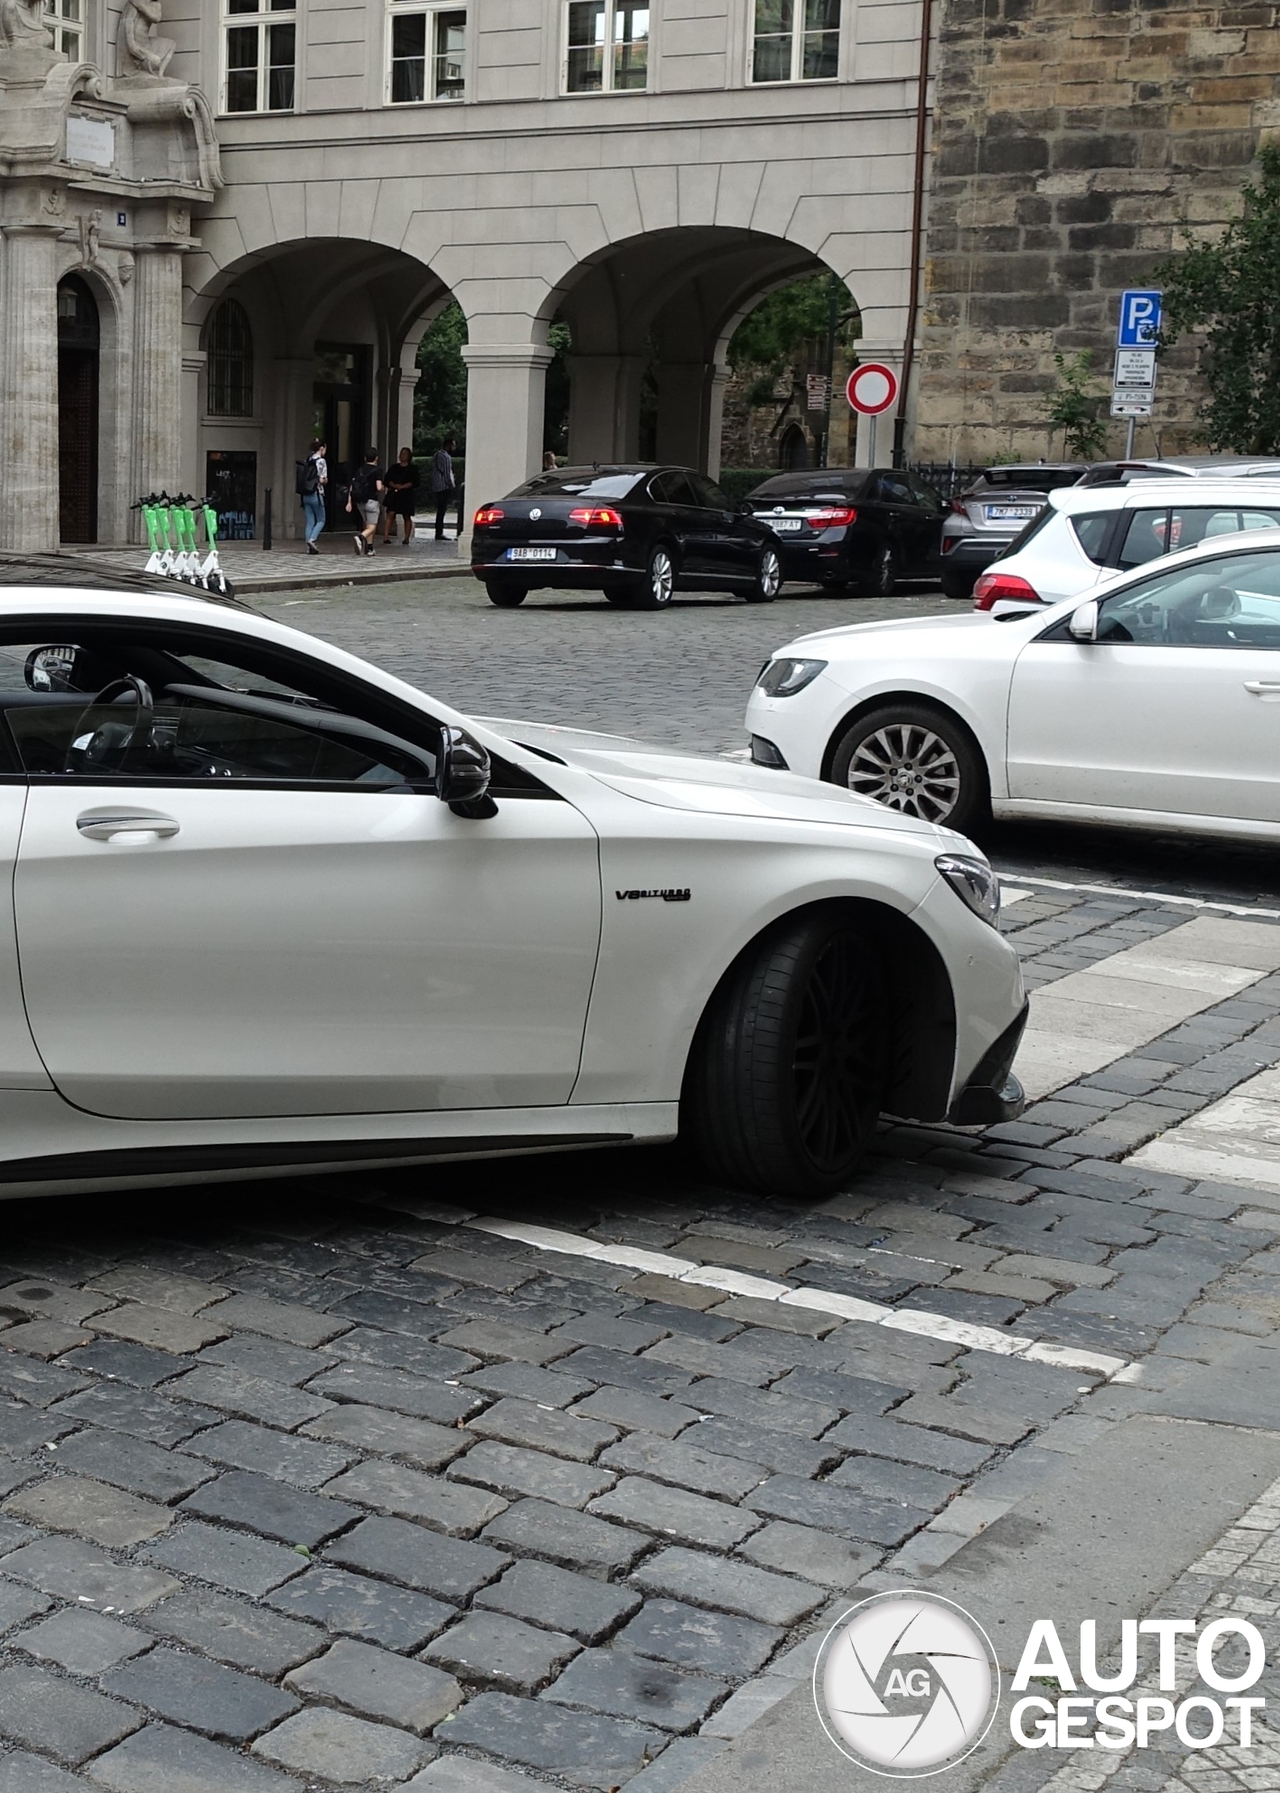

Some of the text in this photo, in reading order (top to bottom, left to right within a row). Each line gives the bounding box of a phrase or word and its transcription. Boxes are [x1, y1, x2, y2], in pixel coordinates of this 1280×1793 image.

[1128, 298, 1153, 329] P
[789, 520, 800, 528] AT
[513, 548, 552, 557] 9AB 0114
[615, 890, 641, 900] V8
